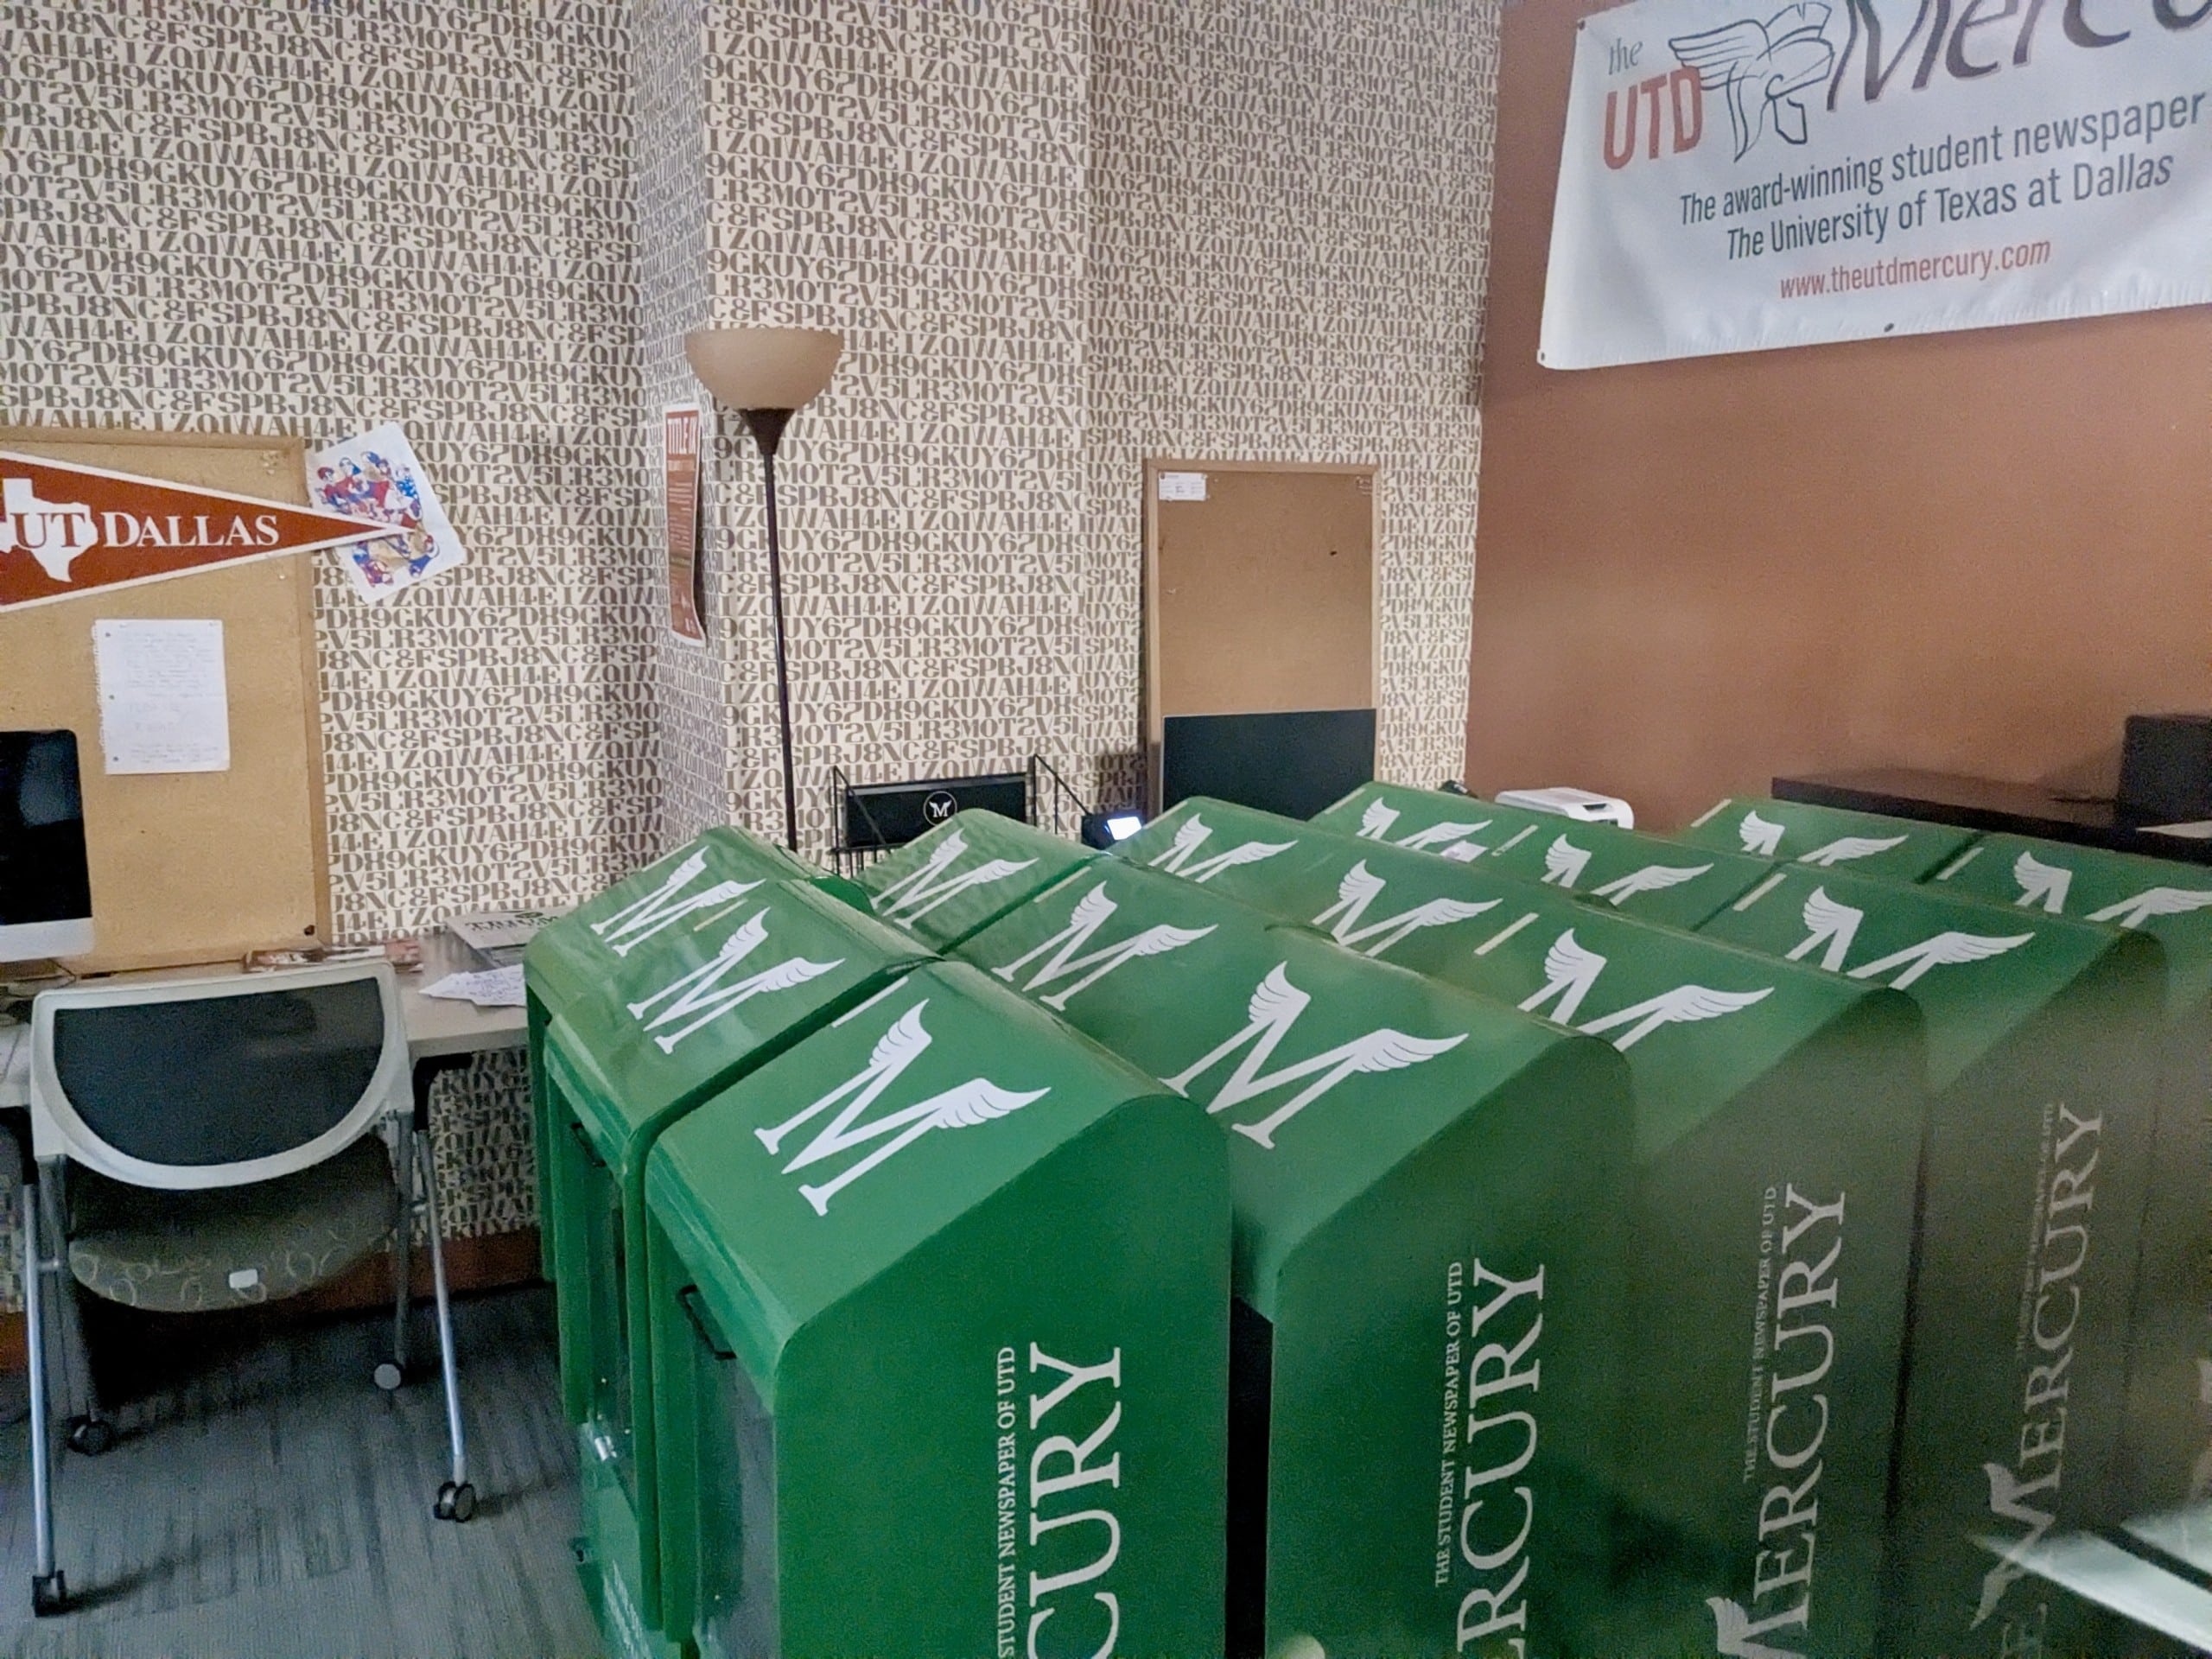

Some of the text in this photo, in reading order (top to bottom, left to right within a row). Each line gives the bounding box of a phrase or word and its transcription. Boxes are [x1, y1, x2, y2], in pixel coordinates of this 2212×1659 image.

[1608, 37, 1643, 75] the
[1604, 66, 1703, 170] UTD
[1681, 92, 2206, 225] The award-winning student newspaper
[1728, 153, 2174, 260] The University of Texas at Dallas
[1780, 239, 2051, 299] www.theutdmercury.com
[10, 511, 280, 549] UT DALLAS
[1751, 1258, 1770, 1358] NEWSPAPER
[1434, 1262, 1463, 1588] THE STUDENT NEWSPAPER OF UTD
[1456, 1258, 1545, 1659] RCURY
[996, 1346, 1016, 1658] STUDENT NEWSPAPER OF UTD
